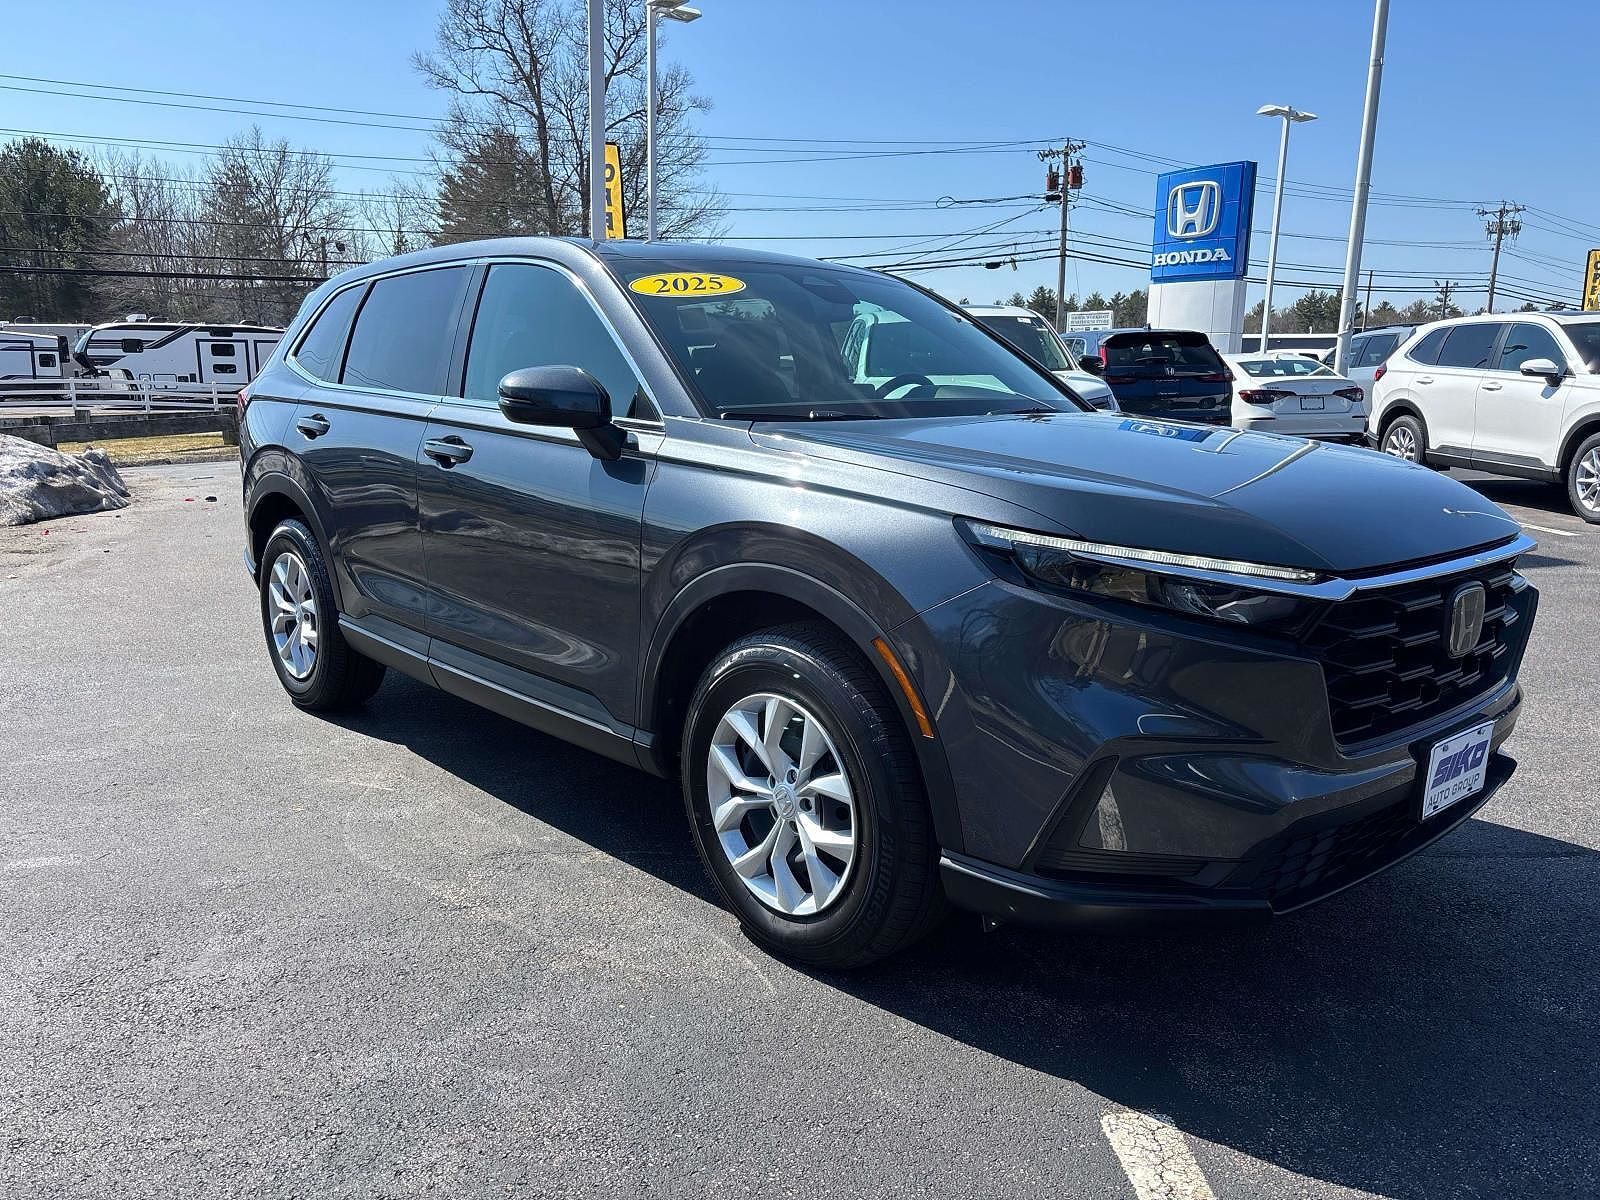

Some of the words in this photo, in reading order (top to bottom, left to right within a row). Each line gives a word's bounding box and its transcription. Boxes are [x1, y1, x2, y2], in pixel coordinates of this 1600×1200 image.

[1153, 248, 1231, 267] HONDA
[653, 277, 723, 293] 2025
[1430, 740, 1489, 789] SILKO
[1428, 787, 1451, 808] AUTO
[1451, 773, 1480, 795] GROUP
